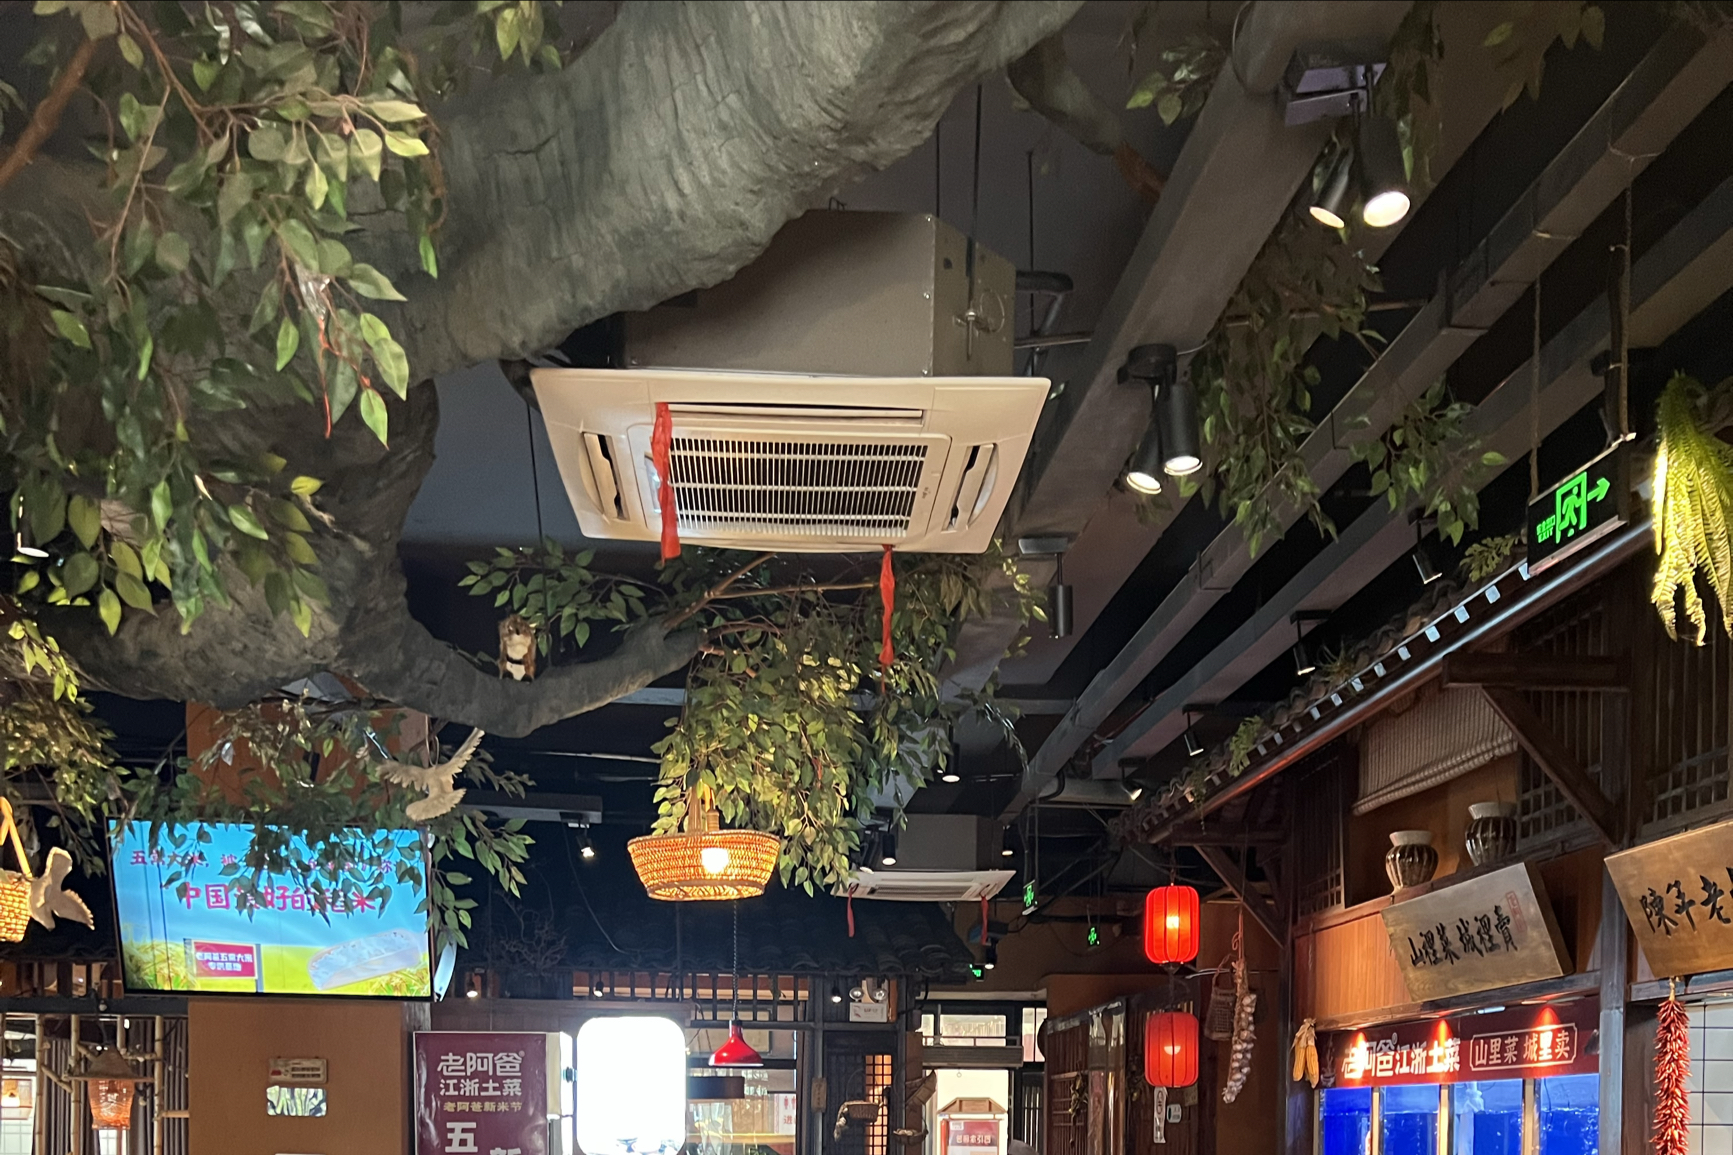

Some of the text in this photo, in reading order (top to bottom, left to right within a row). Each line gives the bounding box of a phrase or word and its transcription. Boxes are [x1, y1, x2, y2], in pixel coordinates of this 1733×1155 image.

[1640, 867, 1733, 936] 陳年老
[1475, 1030, 1570, 1067] 山里菜 城里卖
[437, 1052, 522, 1076] 老阿爸
[440, 1078, 522, 1097] 江浙土菜
[443, 1101, 523, 1113] 老阿爸新米节
